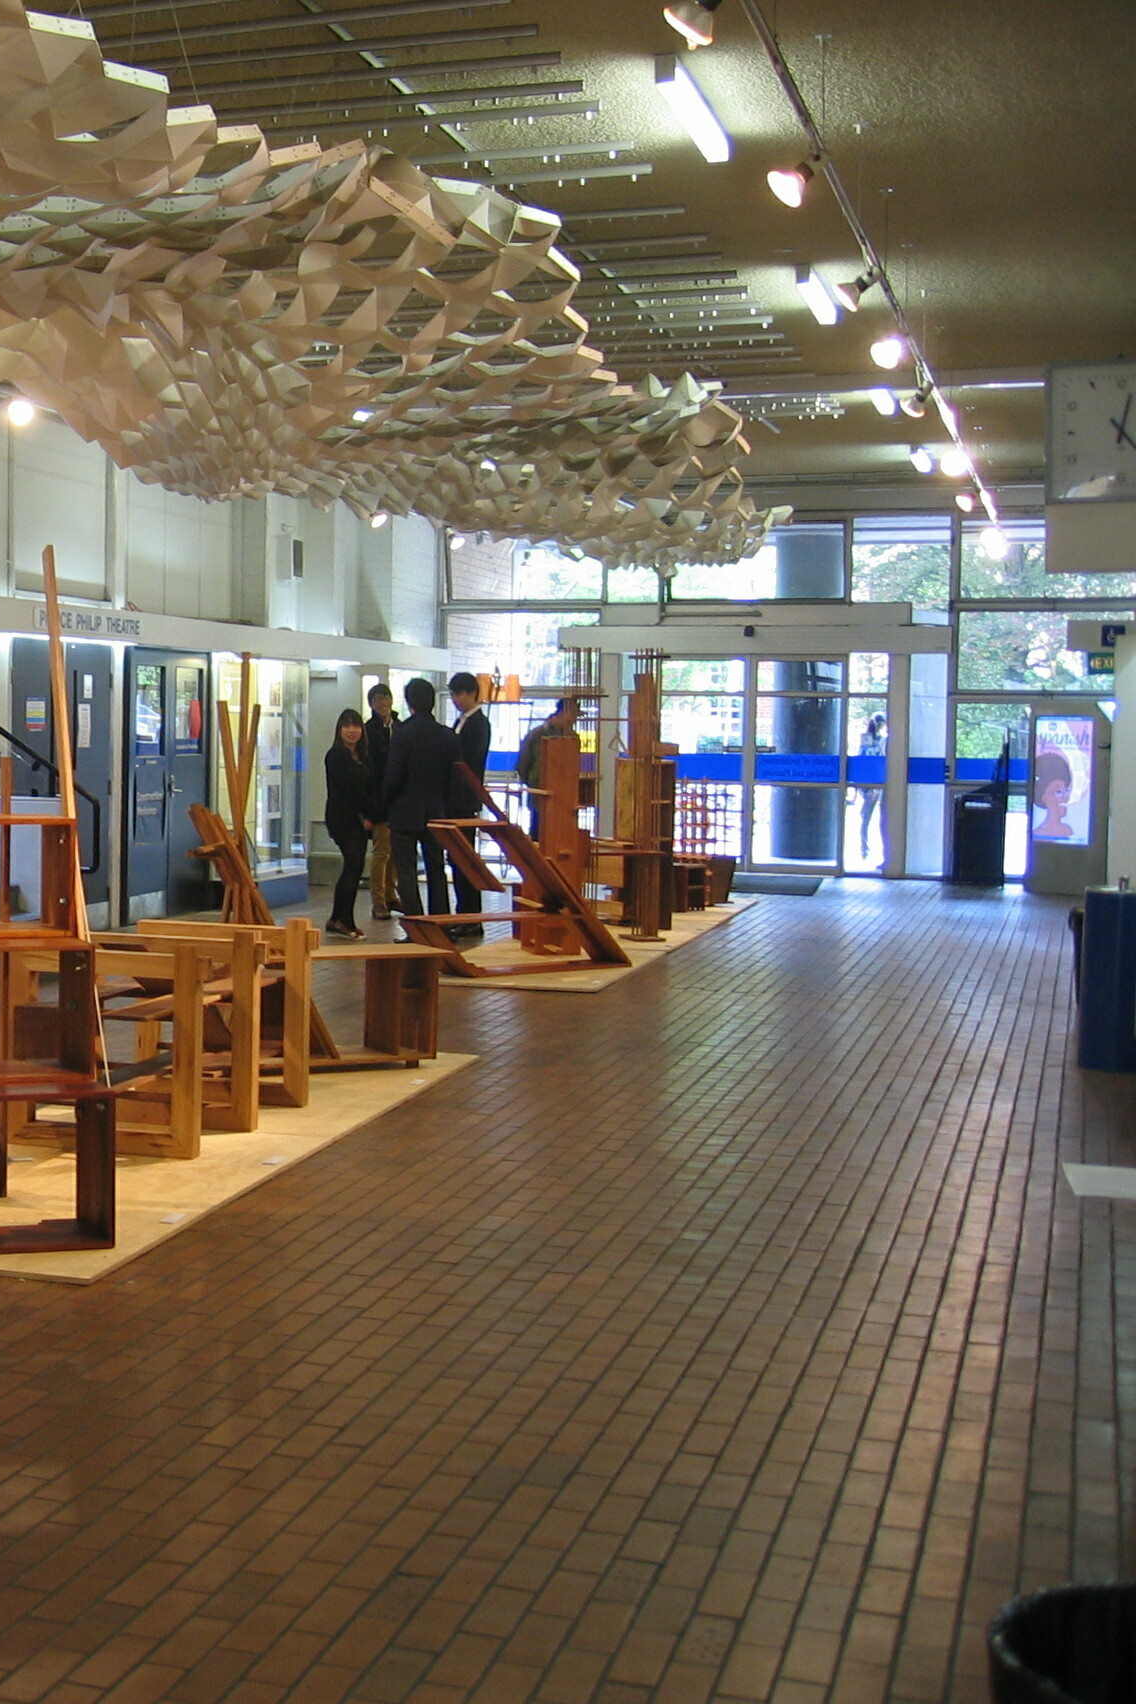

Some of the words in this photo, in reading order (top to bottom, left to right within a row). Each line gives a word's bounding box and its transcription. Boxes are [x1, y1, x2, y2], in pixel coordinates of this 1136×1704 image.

[39, 609, 72, 629] PCE
[75, 613, 102, 631] PHILIP
[105, 616, 140, 635] THEATRE
